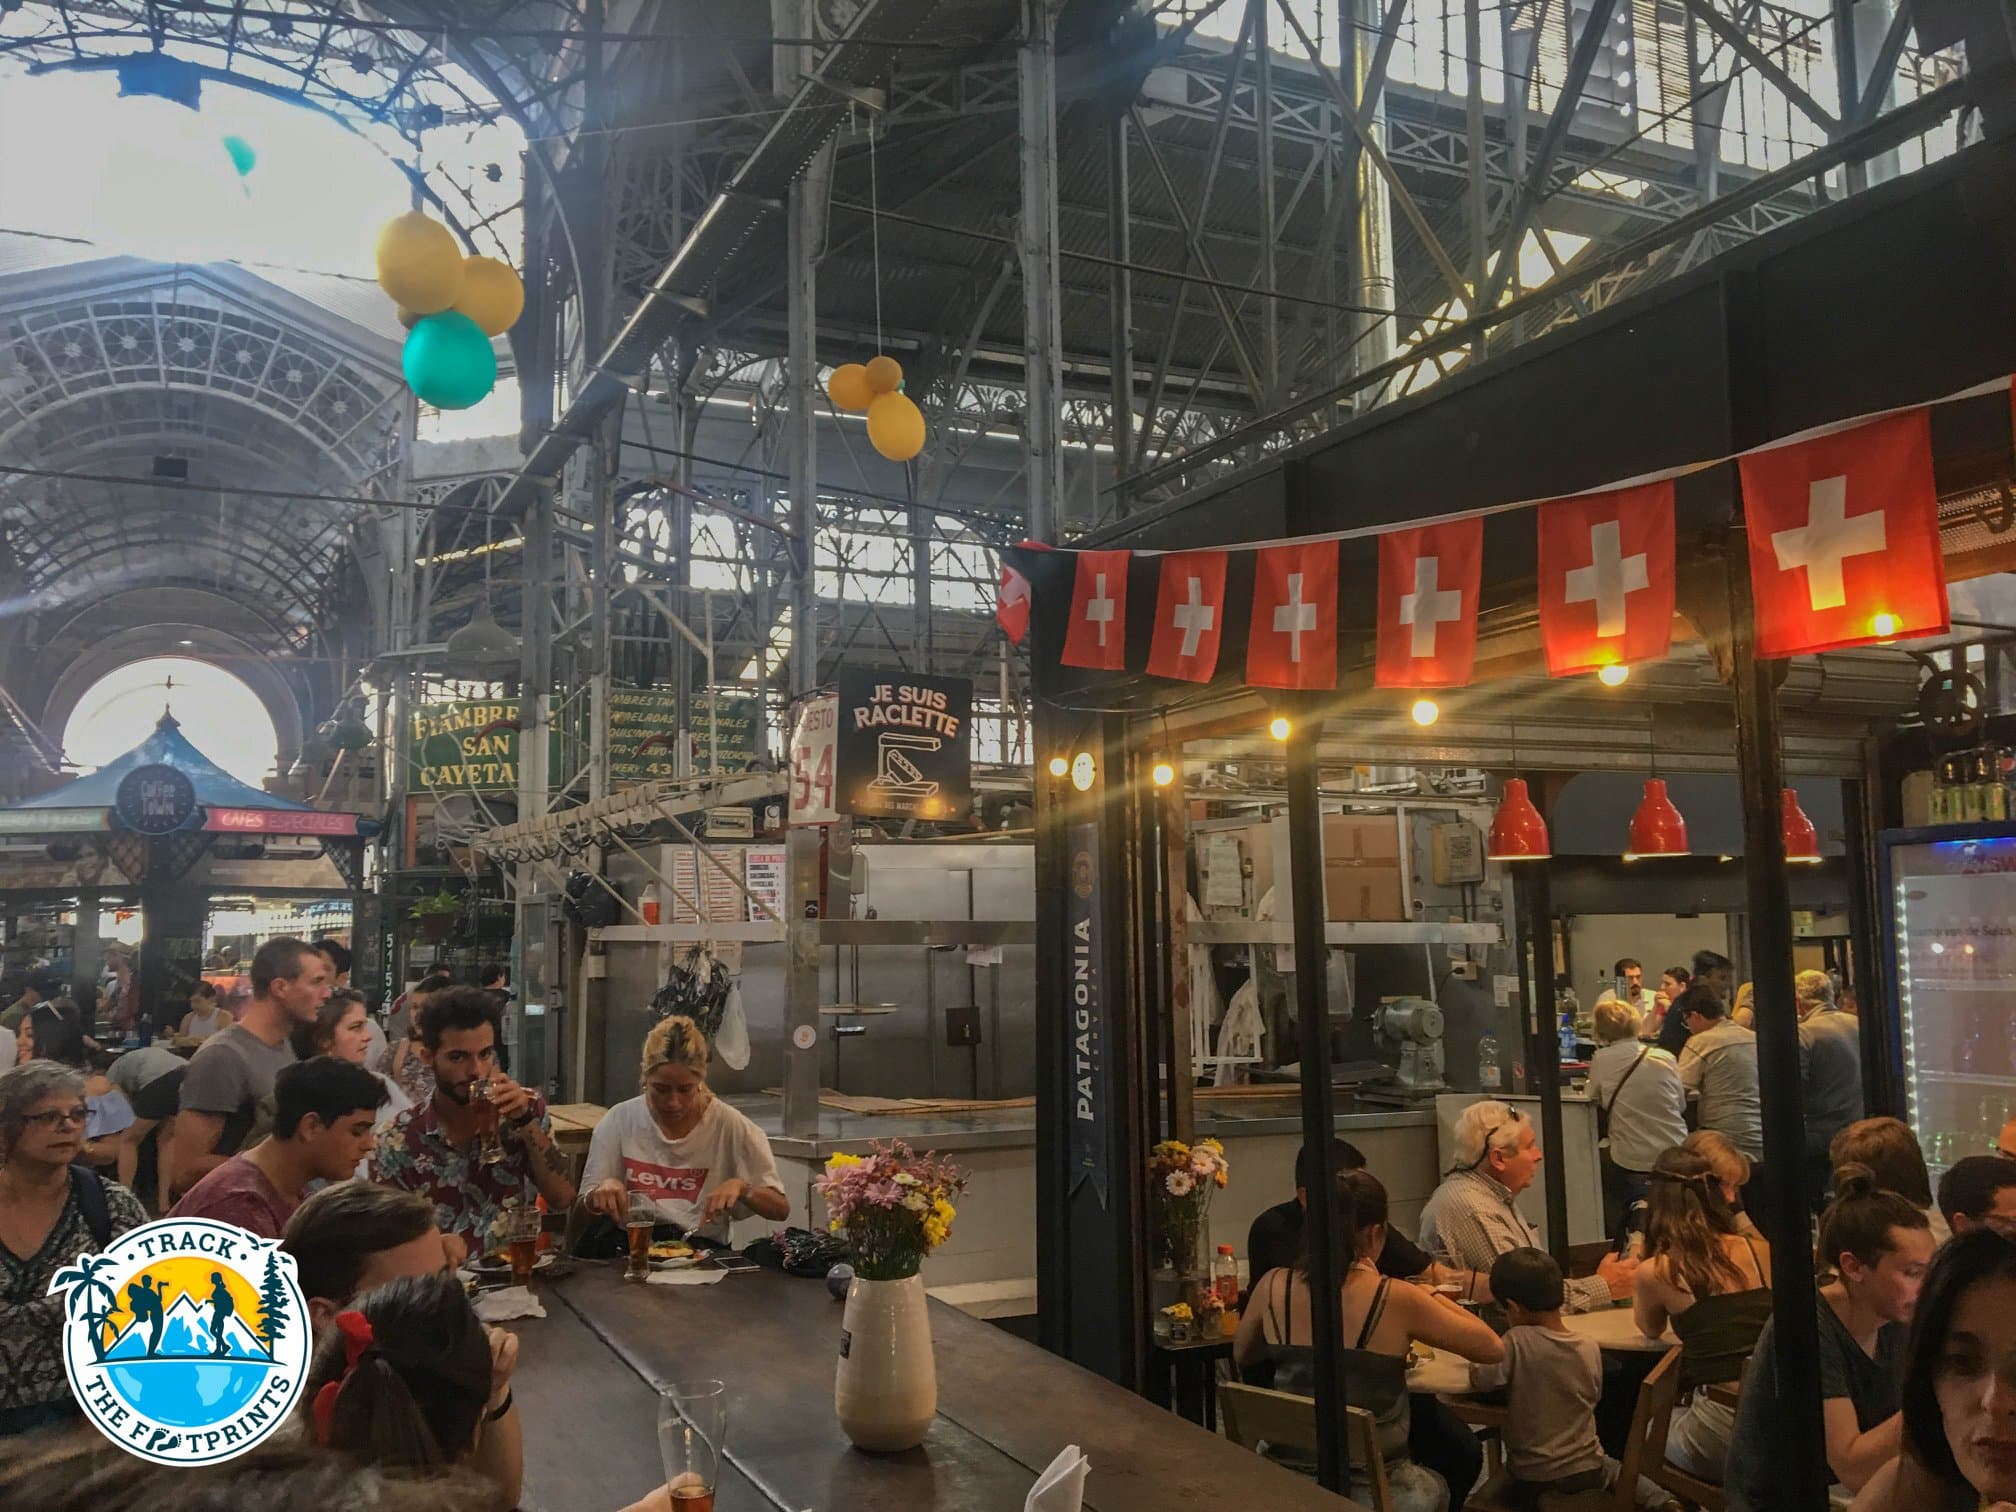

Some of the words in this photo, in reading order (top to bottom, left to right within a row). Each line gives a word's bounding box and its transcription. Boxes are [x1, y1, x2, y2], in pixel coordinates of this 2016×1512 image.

[870, 684, 893, 703] JE
[898, 685, 948, 710] SUIS
[853, 704, 960, 739] RACLETTE
[463, 734, 510, 756] SAN
[420, 762, 520, 786] CAYETA
[794, 743, 833, 810] 54
[1074, 917, 1095, 1122] PATAGONIA
[625, 1167, 698, 1191] Levi's
